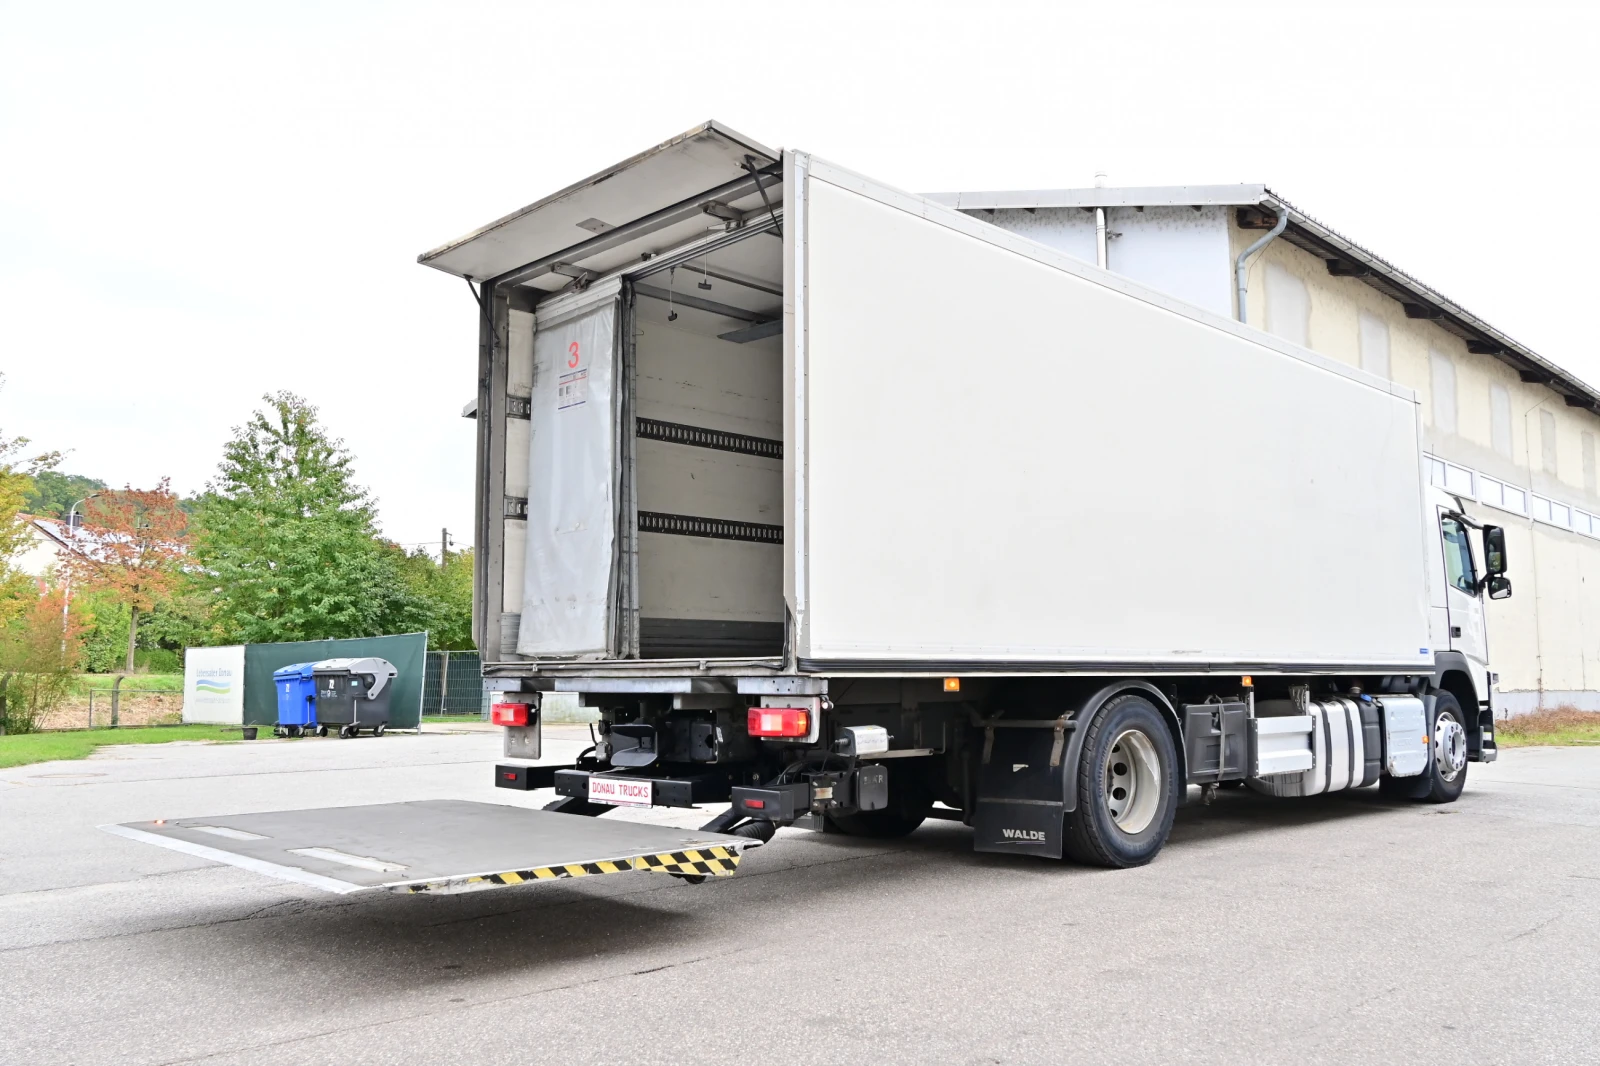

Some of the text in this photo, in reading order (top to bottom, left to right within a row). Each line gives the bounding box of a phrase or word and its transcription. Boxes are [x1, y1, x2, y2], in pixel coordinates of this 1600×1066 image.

[568, 341, 580, 368] 3
[592, 781, 649, 798] DONAU TRUCKS
[1002, 828, 1046, 841] WALDE
